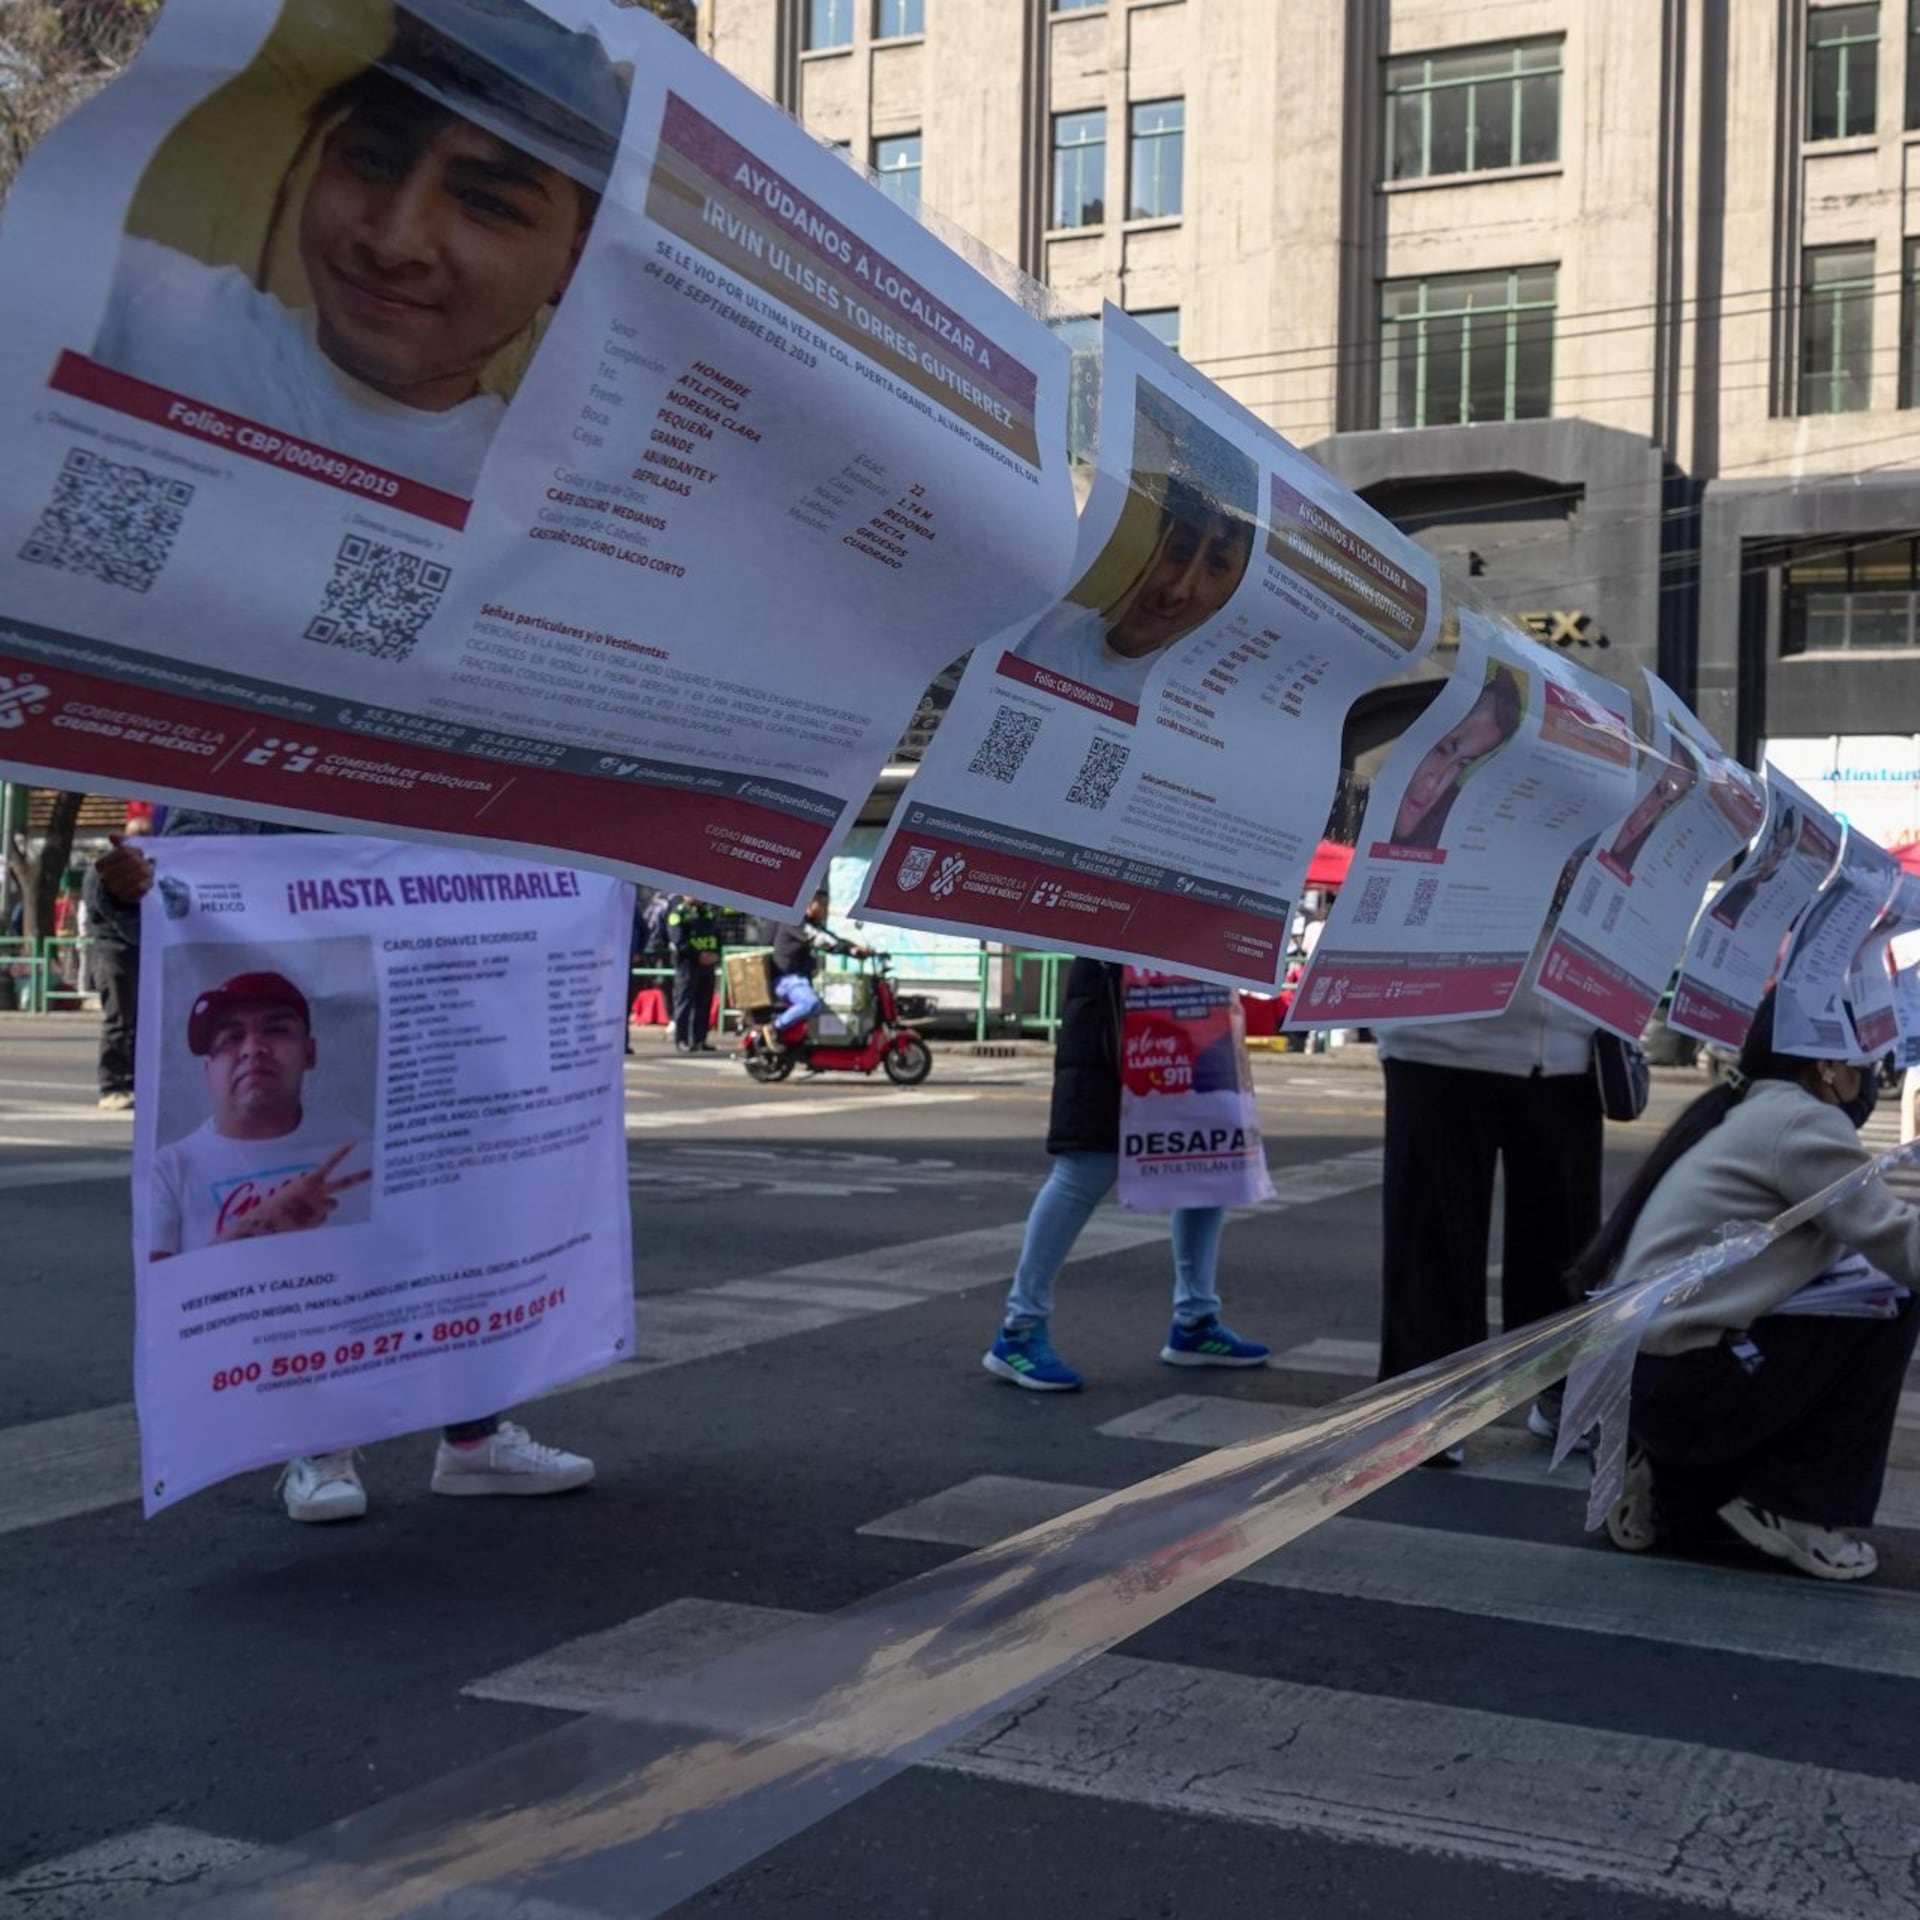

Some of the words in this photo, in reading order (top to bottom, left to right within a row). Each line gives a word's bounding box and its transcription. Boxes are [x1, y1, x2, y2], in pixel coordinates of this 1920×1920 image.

[735, 162, 852, 264] AYÚDANOS
[855, 255, 870, 281] A
[874, 267, 974, 358] LOCALIZAR
[978, 348, 992, 371] A
[644, 261, 662, 278] 04
[663, 272, 685, 292] DE
[683, 283, 768, 339] SEPTIEMBRE
[764, 329, 788, 353] DEL
[788, 345, 818, 369] 2019
[702, 197, 764, 258] IRVIN
[768, 242, 840, 310] ULISES
[844, 296, 918, 363] TORRES
[920, 351, 1014, 430] GUTIERREZ
[656, 240, 672, 260] SE
[675, 250, 692, 271] LE
[694, 262, 716, 285] VIO
[717, 277, 745, 302] POR
[746, 295, 789, 328] ULTIMA
[790, 319, 811, 343] VEZ
[812, 335, 828, 353] EN
[830, 345, 853, 368] COL.
[854, 361, 896, 394] PUERTA
[938, 413, 972, 444] ALVARO
[1014, 461, 1024, 477] EL
[677, 374, 741, 413] ATLETICA
[692, 360, 753, 399] HOMBRE
[656, 407, 714, 441] PEQUEÑA
[666, 389, 720, 423] MORENA
[720, 413, 763, 444] CLARA
[167, 401, 234, 440] Folio:
[236, 425, 400, 499] CBP/00049/2019
[649, 428, 697, 455] GRANDE
[631, 467, 693, 498] DEPILADAS
[642, 449, 708, 482] ABUNDANTE
[908, 482, 927, 499] 22
[611, 503, 668, 532] MEDIANOS
[868, 516, 907, 541] RECTA
[882, 507, 937, 542] REDONDA
[571, 533, 616, 558] OSCURO
[616, 548, 649, 569] LACIO
[649, 557, 686, 580] CORTO
[842, 535, 904, 570] CUADRADO
[855, 526, 910, 558] GRUESOS
[1357, 543, 1401, 588] LOCALIZAR
[480, 602, 515, 622] Señas
[516, 612, 585, 641] particulares
[604, 634, 671, 661] Vestimentas:
[52, 714, 123, 738] CIUDAD
[122, 726, 147, 744] DE
[148, 730, 216, 757] MÉXICO
[62, 701, 169, 733] GOBIERNO
[171, 723, 195, 740] DE
[200, 728, 227, 745] LA
[314, 763, 336, 776] DE
[336, 766, 416, 790] PERSONAS
[324, 752, 402, 780] COMISIÓN
[401, 767, 423, 779] DE
[423, 770, 493, 792] BÚSQUEDA
[730, 846, 783, 870] DERECHOS
[741, 834, 803, 861] INNOVADORA
[286, 877, 395, 915] ¡HASTA
[400, 871, 581, 908] ENCONTRARLE!
[384, 937, 434, 952] CARLOS
[434, 933, 479, 949] CHAVEZ
[479, 929, 538, 945] RODRIGUEZ
[1128, 1056, 1173, 1069] LLAMA
[1175, 1055, 1191, 1066] AL
[1163, 1067, 1193, 1086] 911
[1141, 1163, 1159, 1176] EN
[181, 1285, 254, 1313] VESTIMENTA
[258, 1282, 268, 1293] Y
[269, 1273, 339, 1292] CALZADO:
[205, 1309, 260, 1333] DEPORTIVO
[212, 1361, 262, 1392] 800
[271, 1351, 326, 1377] 509
[335, 1340, 366, 1365] 09
[373, 1331, 405, 1356] 27
[432, 1317, 481, 1342] 800
[489, 1304, 525, 1332] 216
